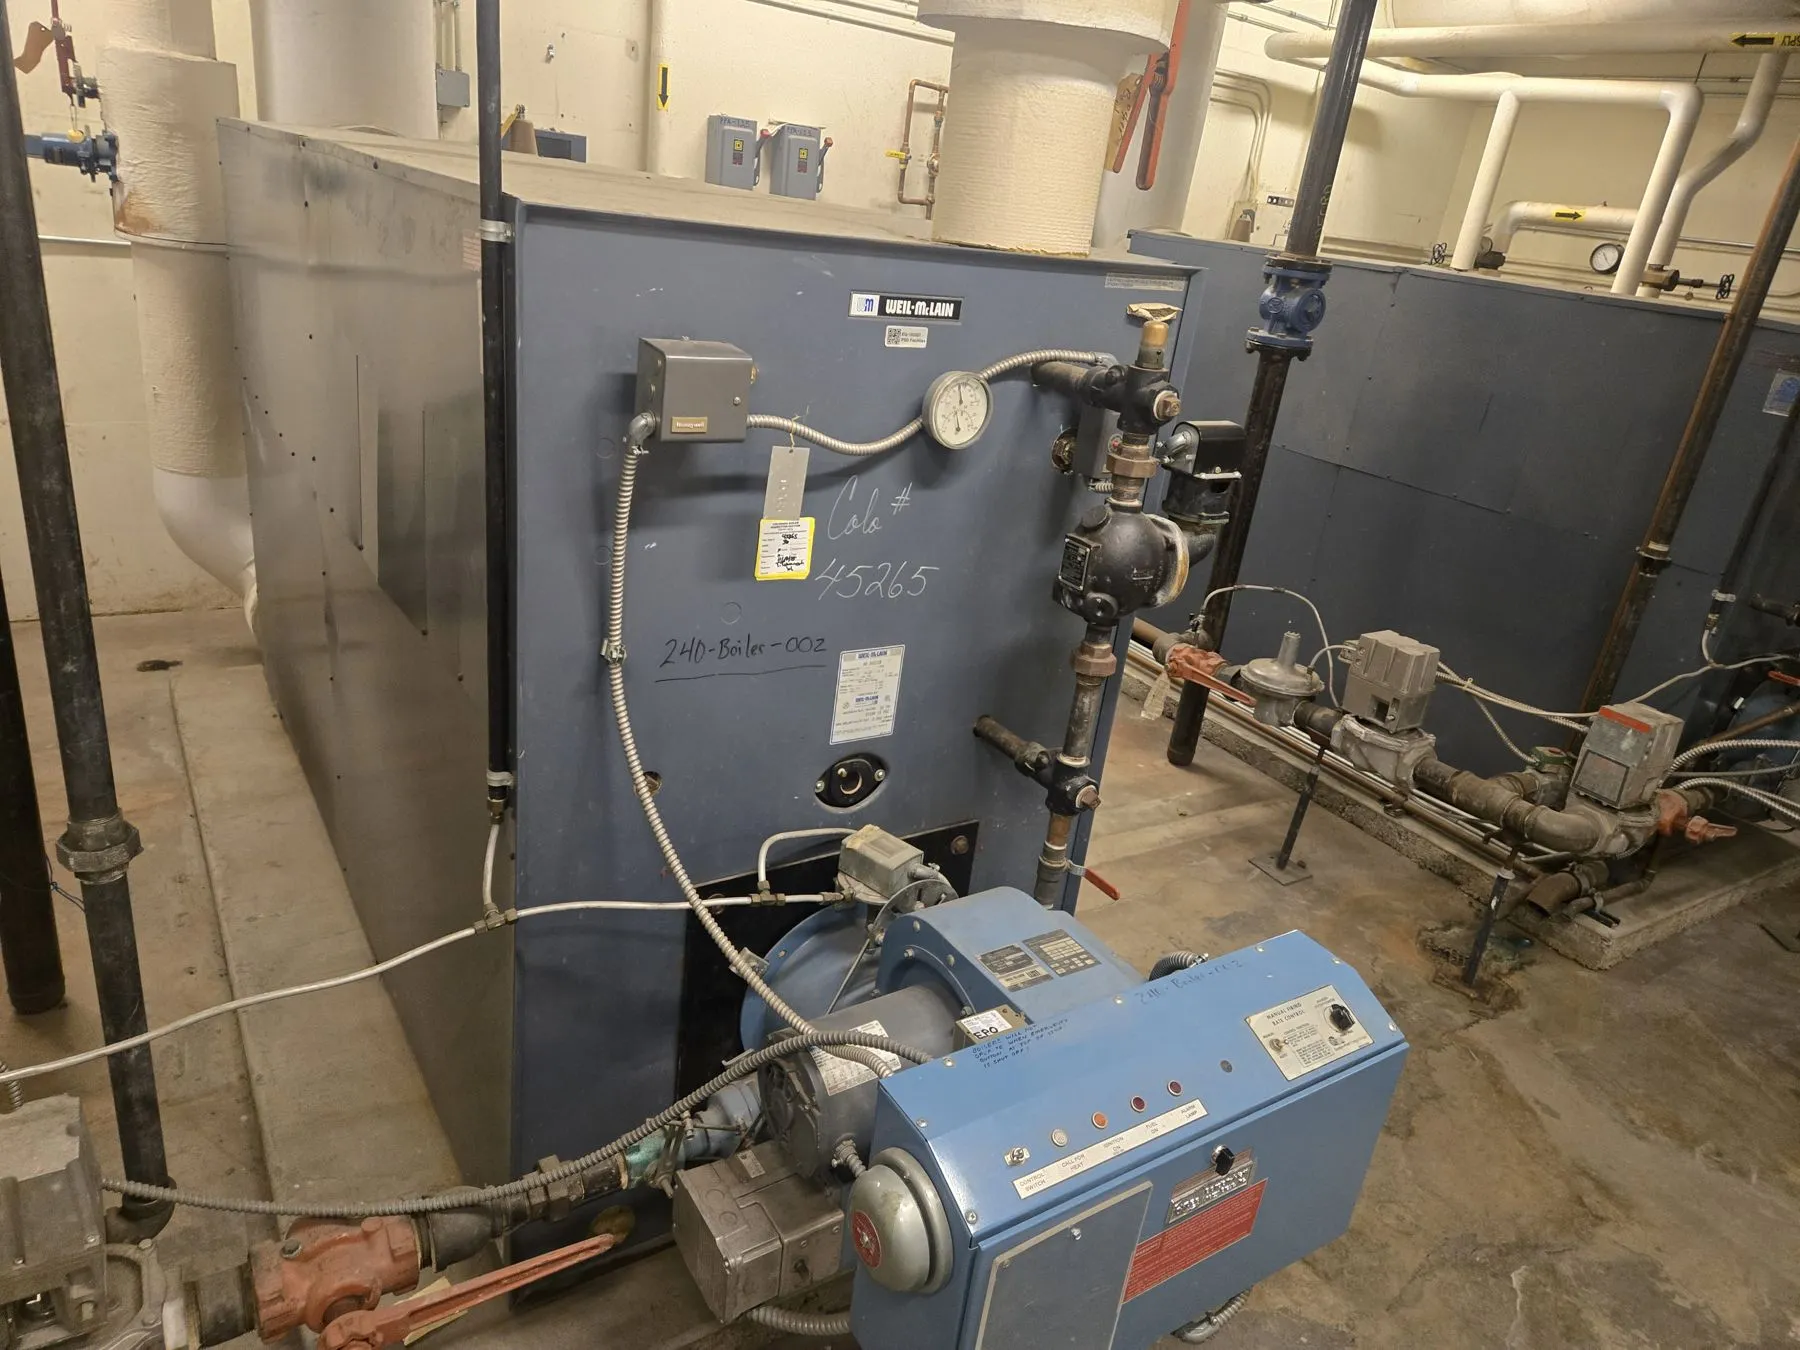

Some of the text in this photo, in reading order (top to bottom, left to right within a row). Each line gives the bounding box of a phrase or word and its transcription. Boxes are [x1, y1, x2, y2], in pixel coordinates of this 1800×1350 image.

[891, 482, 912, 515] #
[815, 558, 940, 600] 45265
[1266, 1008, 1287, 1020] MANUAL
[1019, 1172, 1046, 1187] CONTROL
[1025, 1180, 1047, 1192] SWITCH
